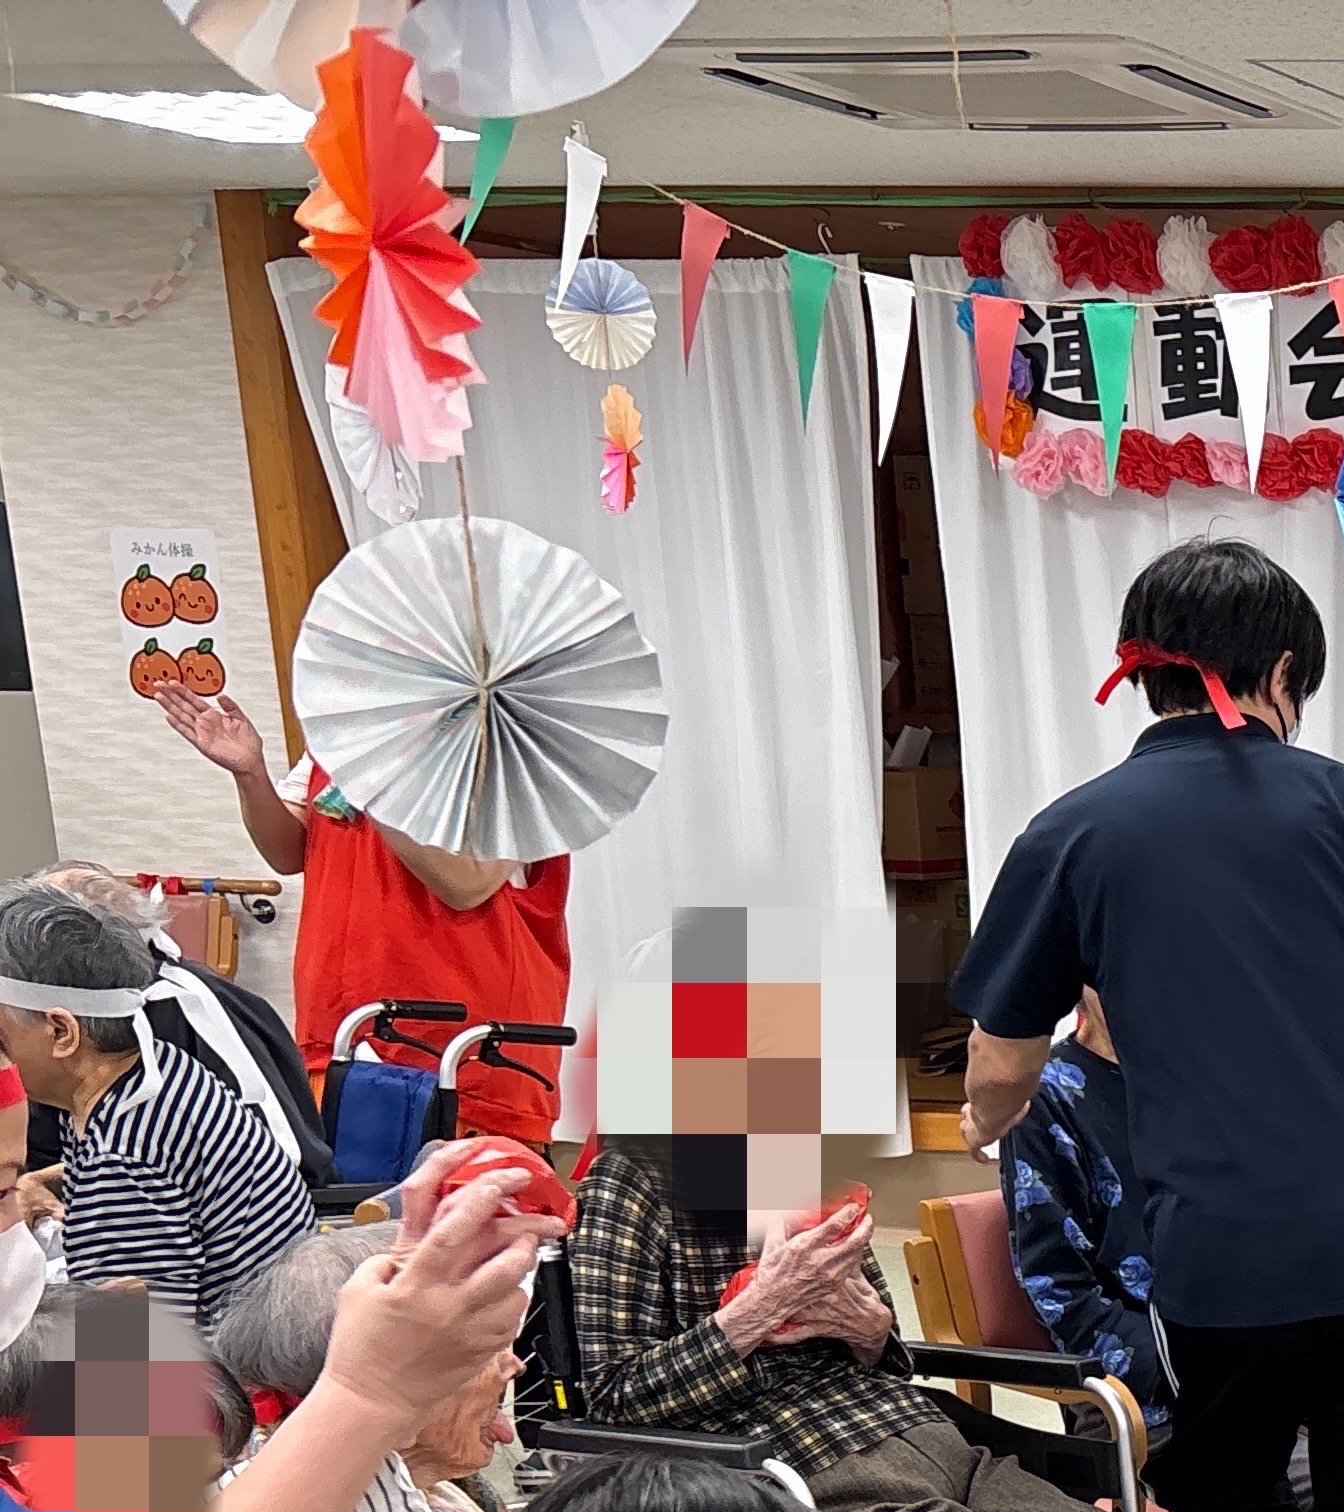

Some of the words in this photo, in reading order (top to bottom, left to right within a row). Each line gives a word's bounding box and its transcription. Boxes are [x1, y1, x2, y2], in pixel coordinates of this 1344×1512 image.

[130, 541, 194, 557] みかん体操
